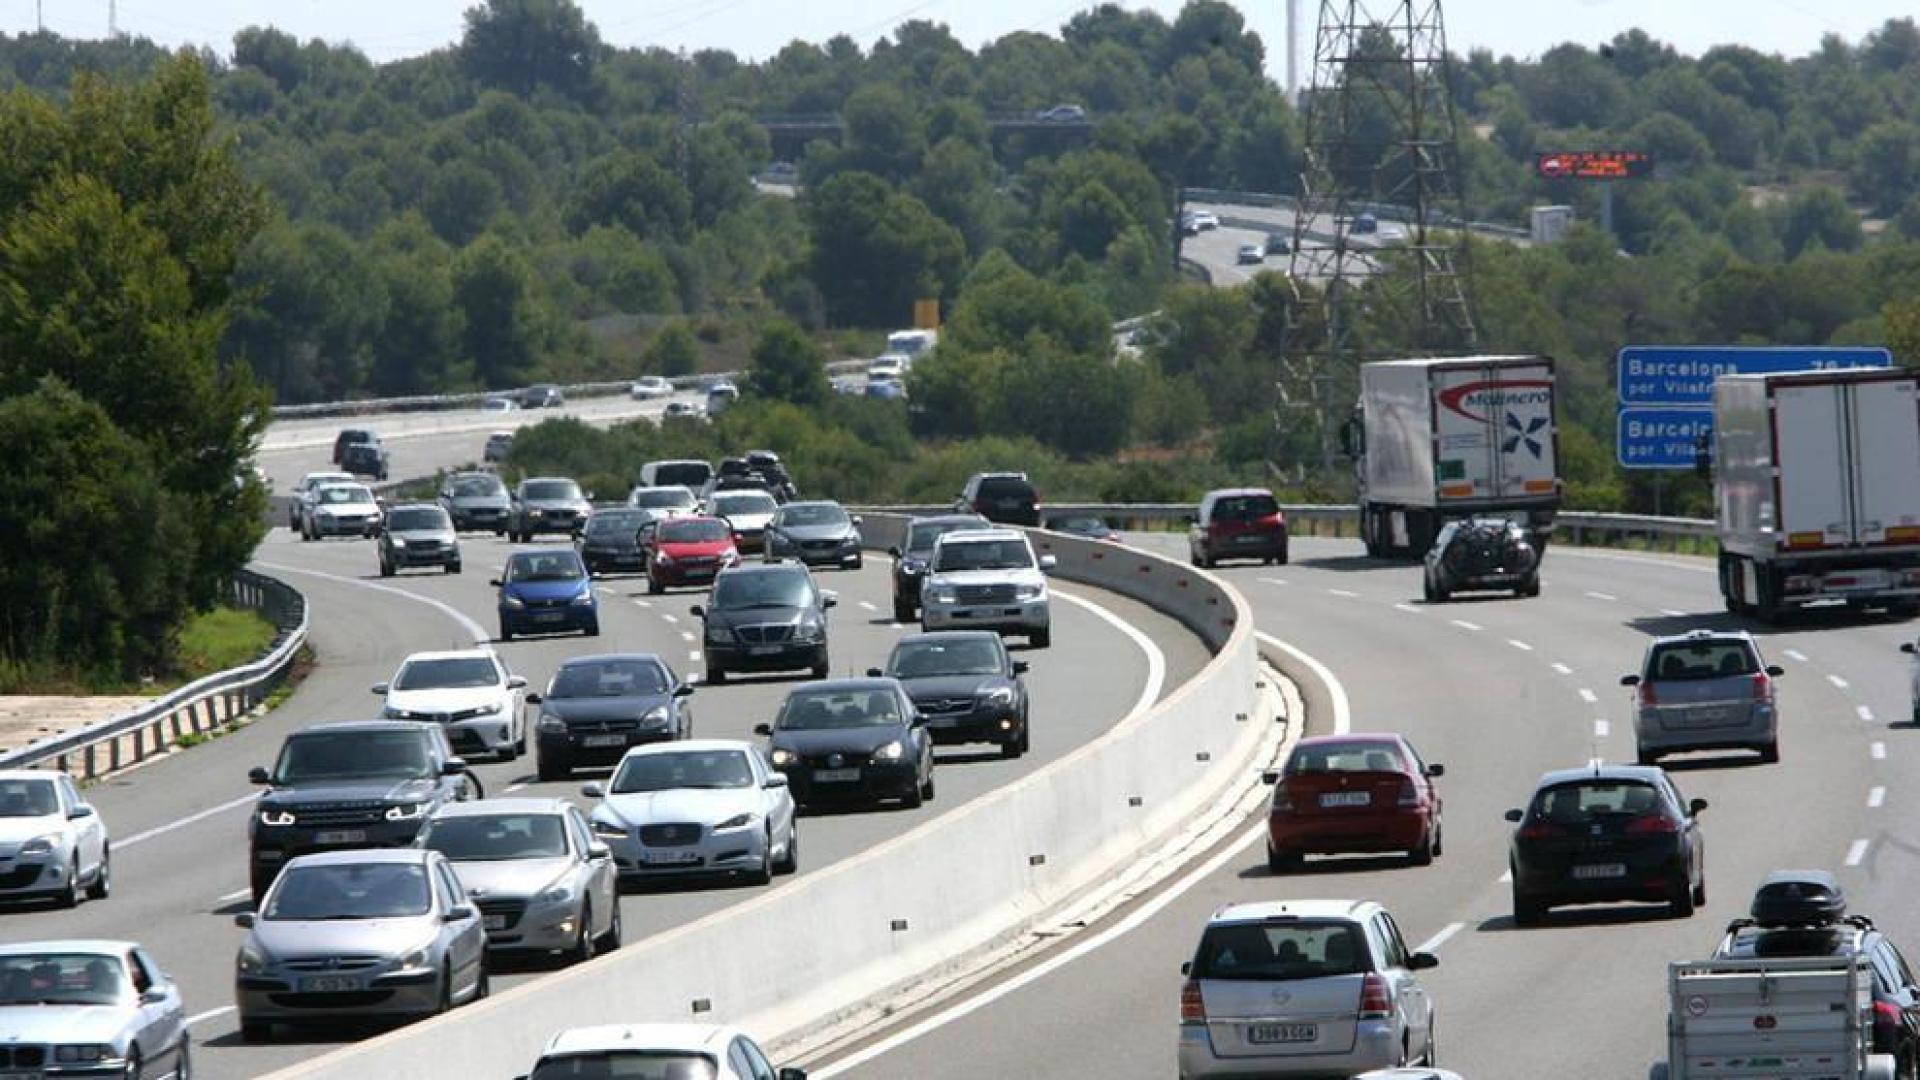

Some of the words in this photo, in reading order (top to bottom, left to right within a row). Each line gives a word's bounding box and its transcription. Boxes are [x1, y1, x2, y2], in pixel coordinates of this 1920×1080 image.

[1628, 359, 1738, 377] Barcelona
[1628, 383, 1655, 397] por
[1663, 380, 1714, 394] Vilafr
[1628, 444, 1655, 458] por
